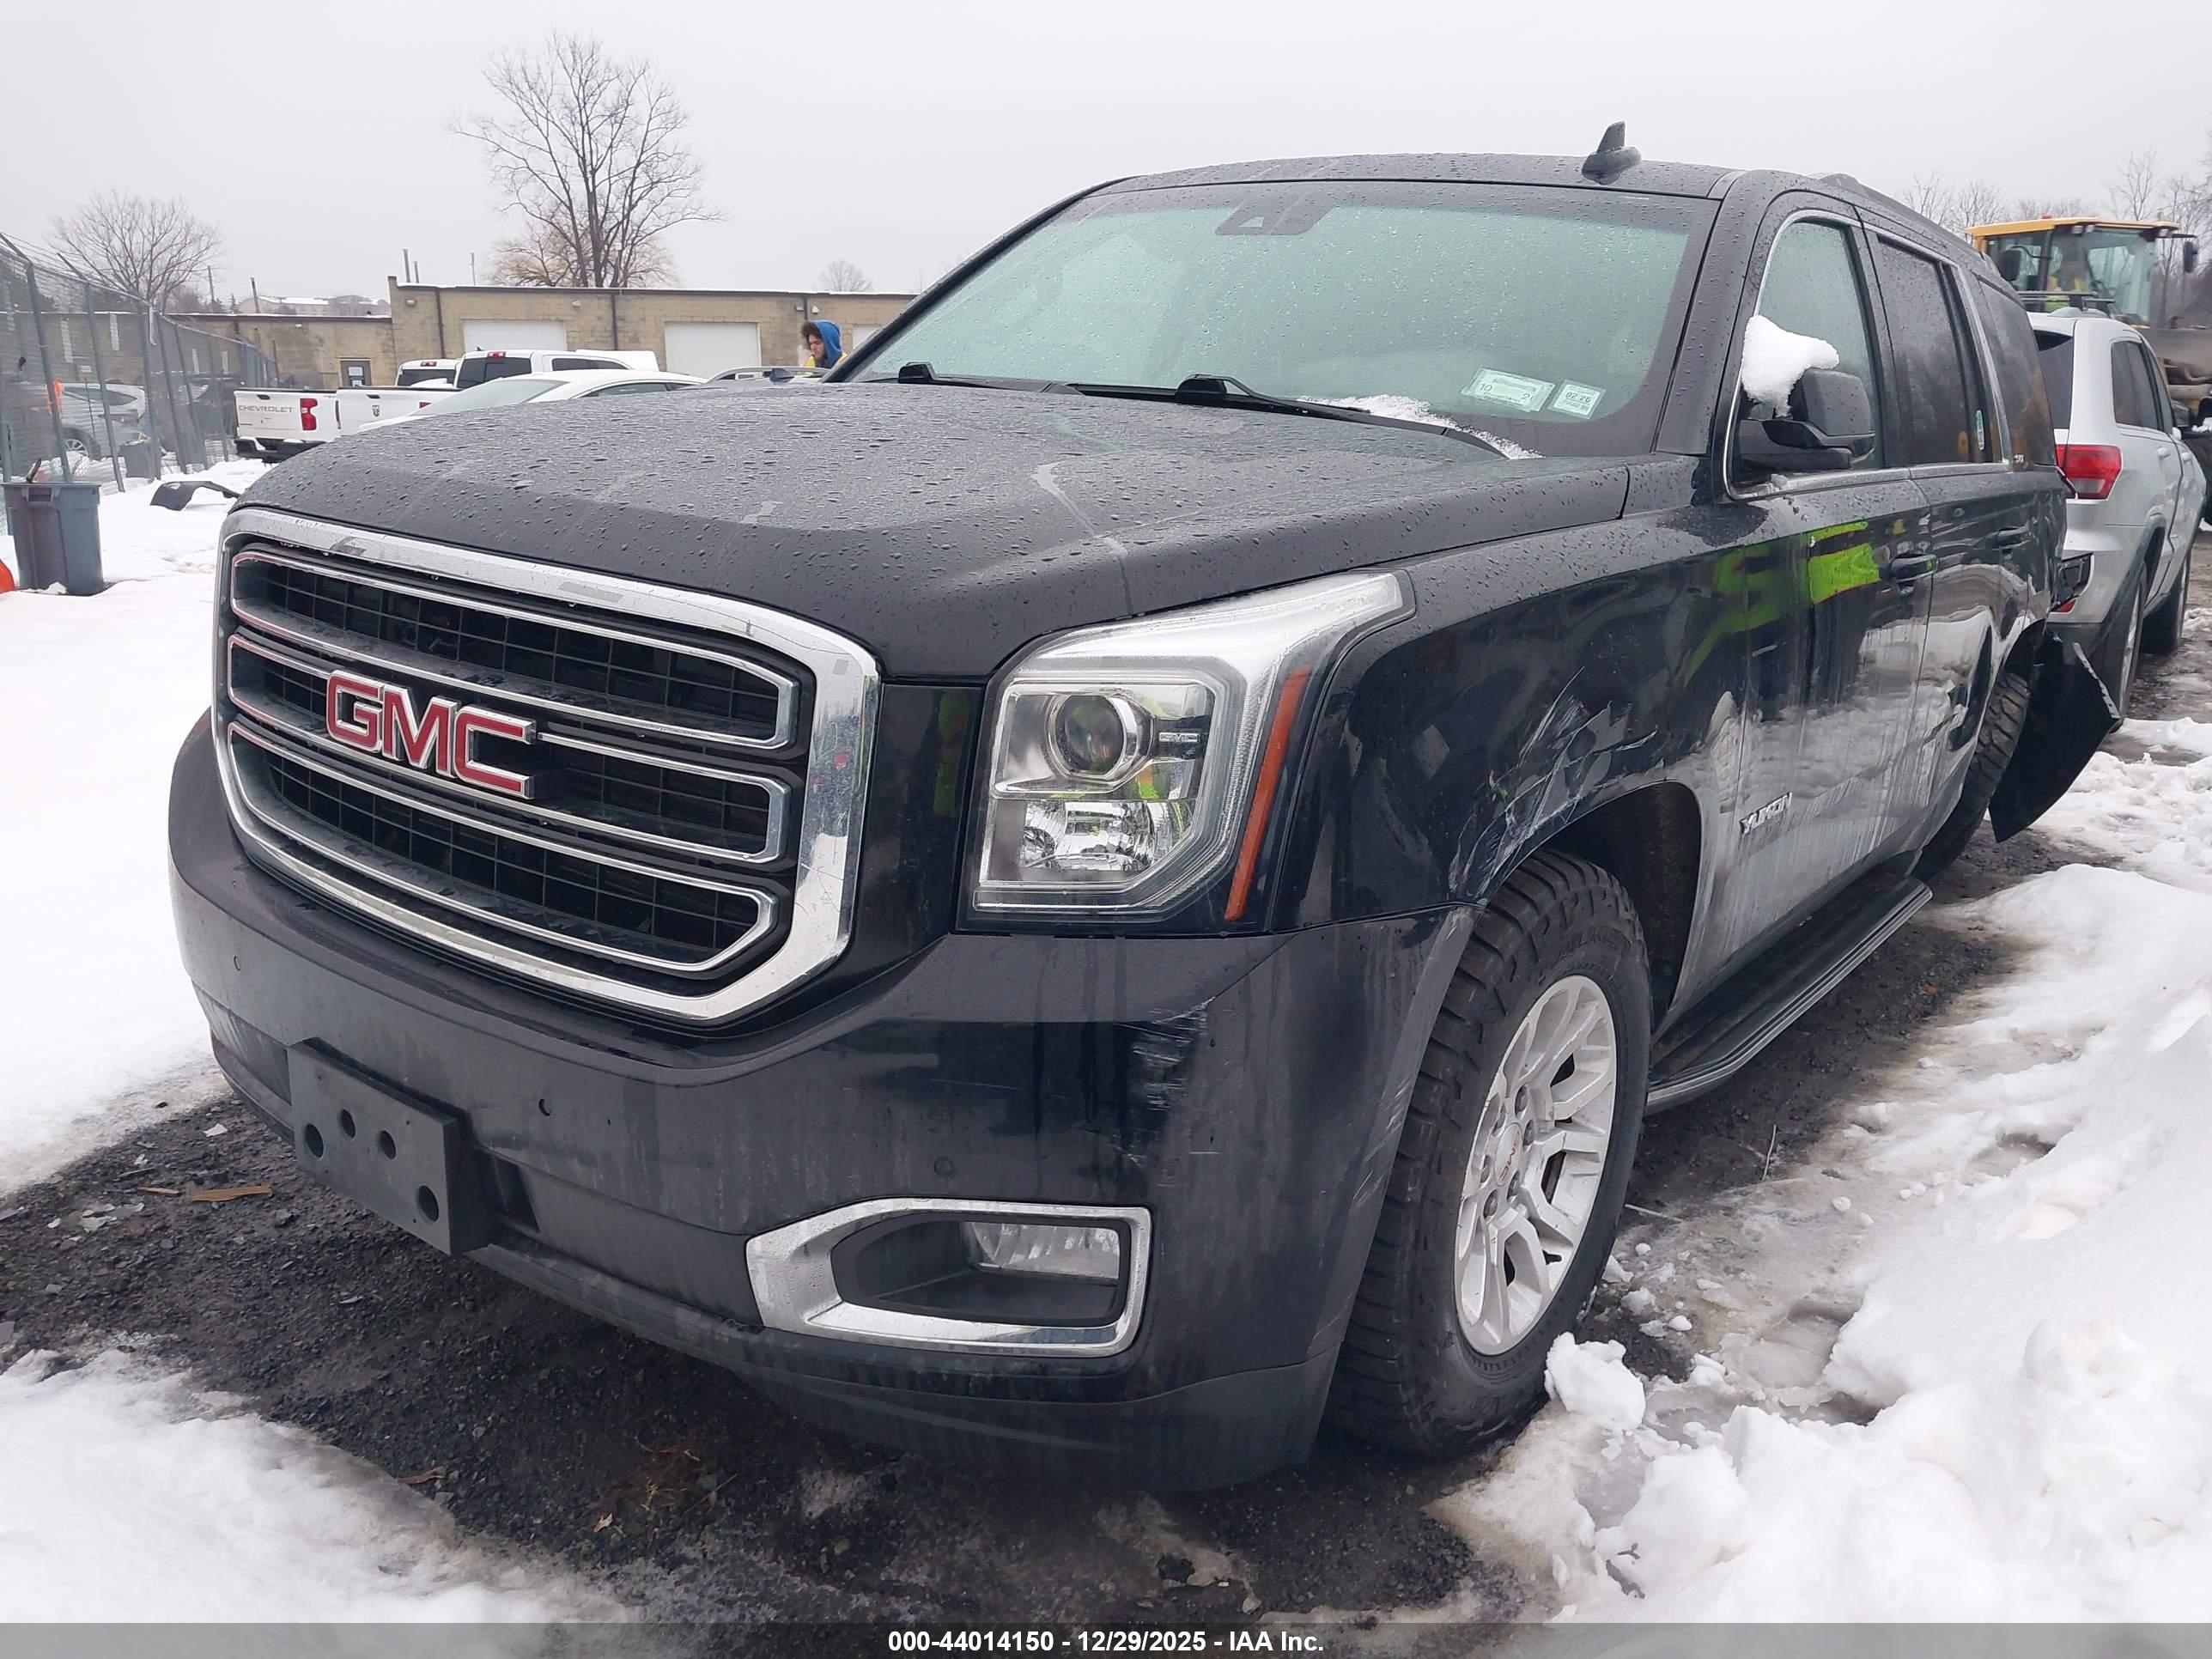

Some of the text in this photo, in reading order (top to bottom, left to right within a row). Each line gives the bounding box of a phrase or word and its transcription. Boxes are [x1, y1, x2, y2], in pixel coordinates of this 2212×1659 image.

[238, 404, 294, 413] CHEVROLET
[326, 669, 537, 800] GMC
[1158, 732, 1200, 744] GMC
[1498, 1127, 1521, 1182] GMC
